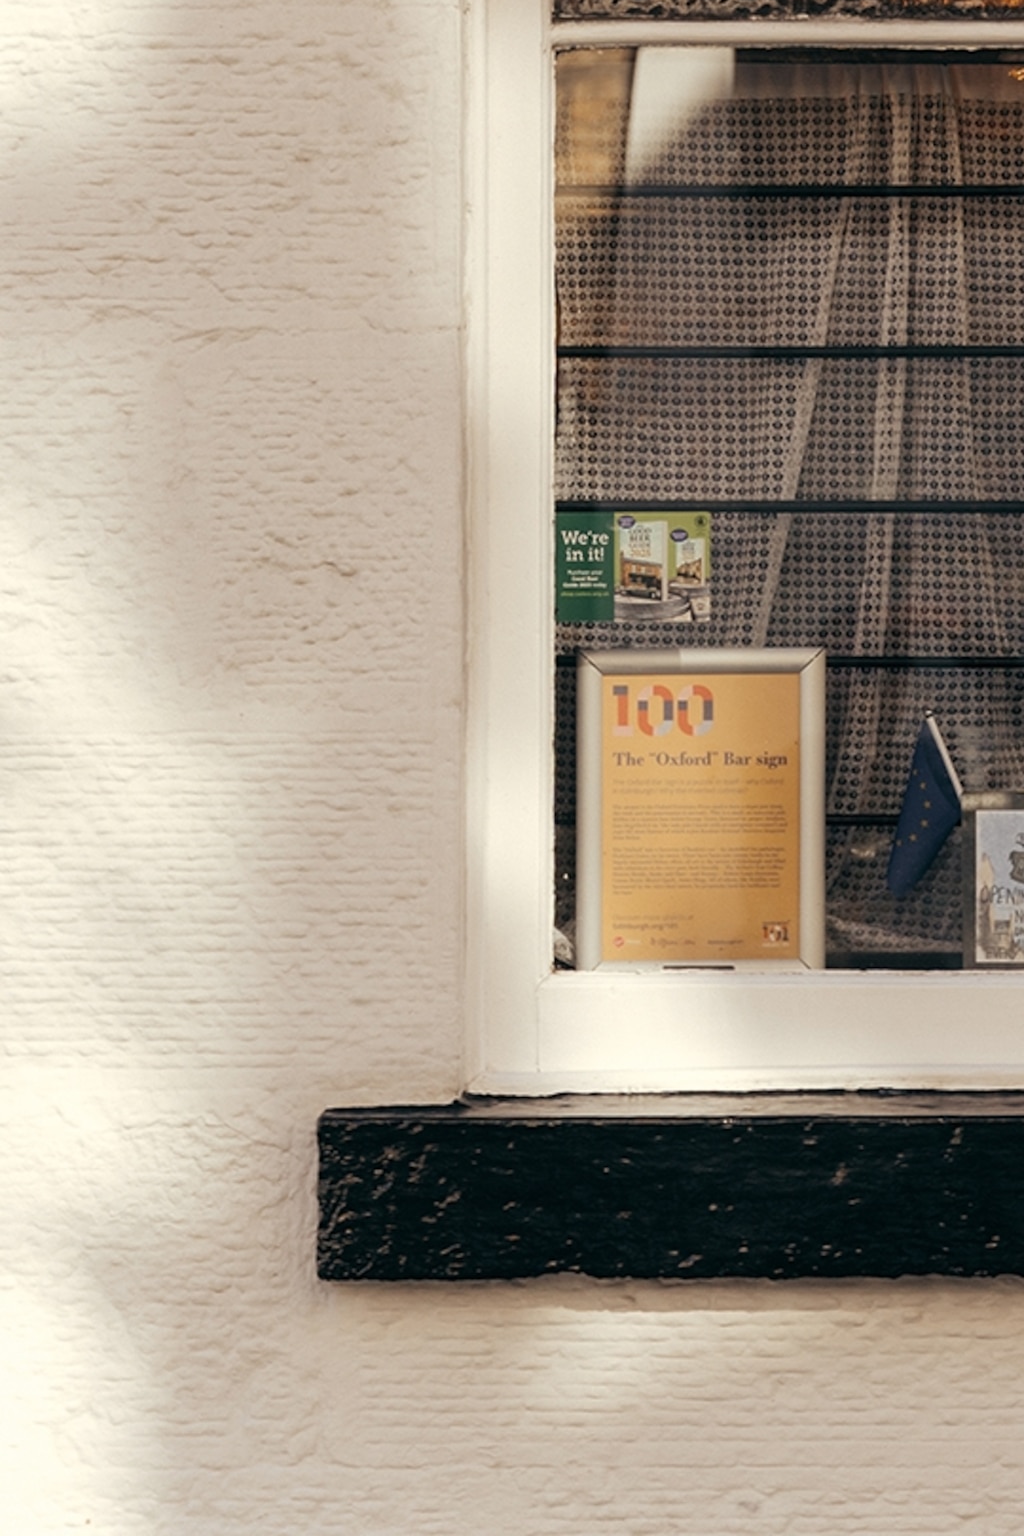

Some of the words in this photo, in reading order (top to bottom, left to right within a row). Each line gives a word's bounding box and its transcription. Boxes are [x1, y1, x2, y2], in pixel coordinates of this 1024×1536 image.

[560, 530, 609, 545] We're
[565, 547, 584, 562] in
[587, 547, 605, 562] it!
[612, 684, 714, 737] 100
[612, 752, 645, 766] The
[649, 751, 719, 766] "Oxford"
[724, 752, 752, 766] Bar
[755, 751, 788, 769] sign
